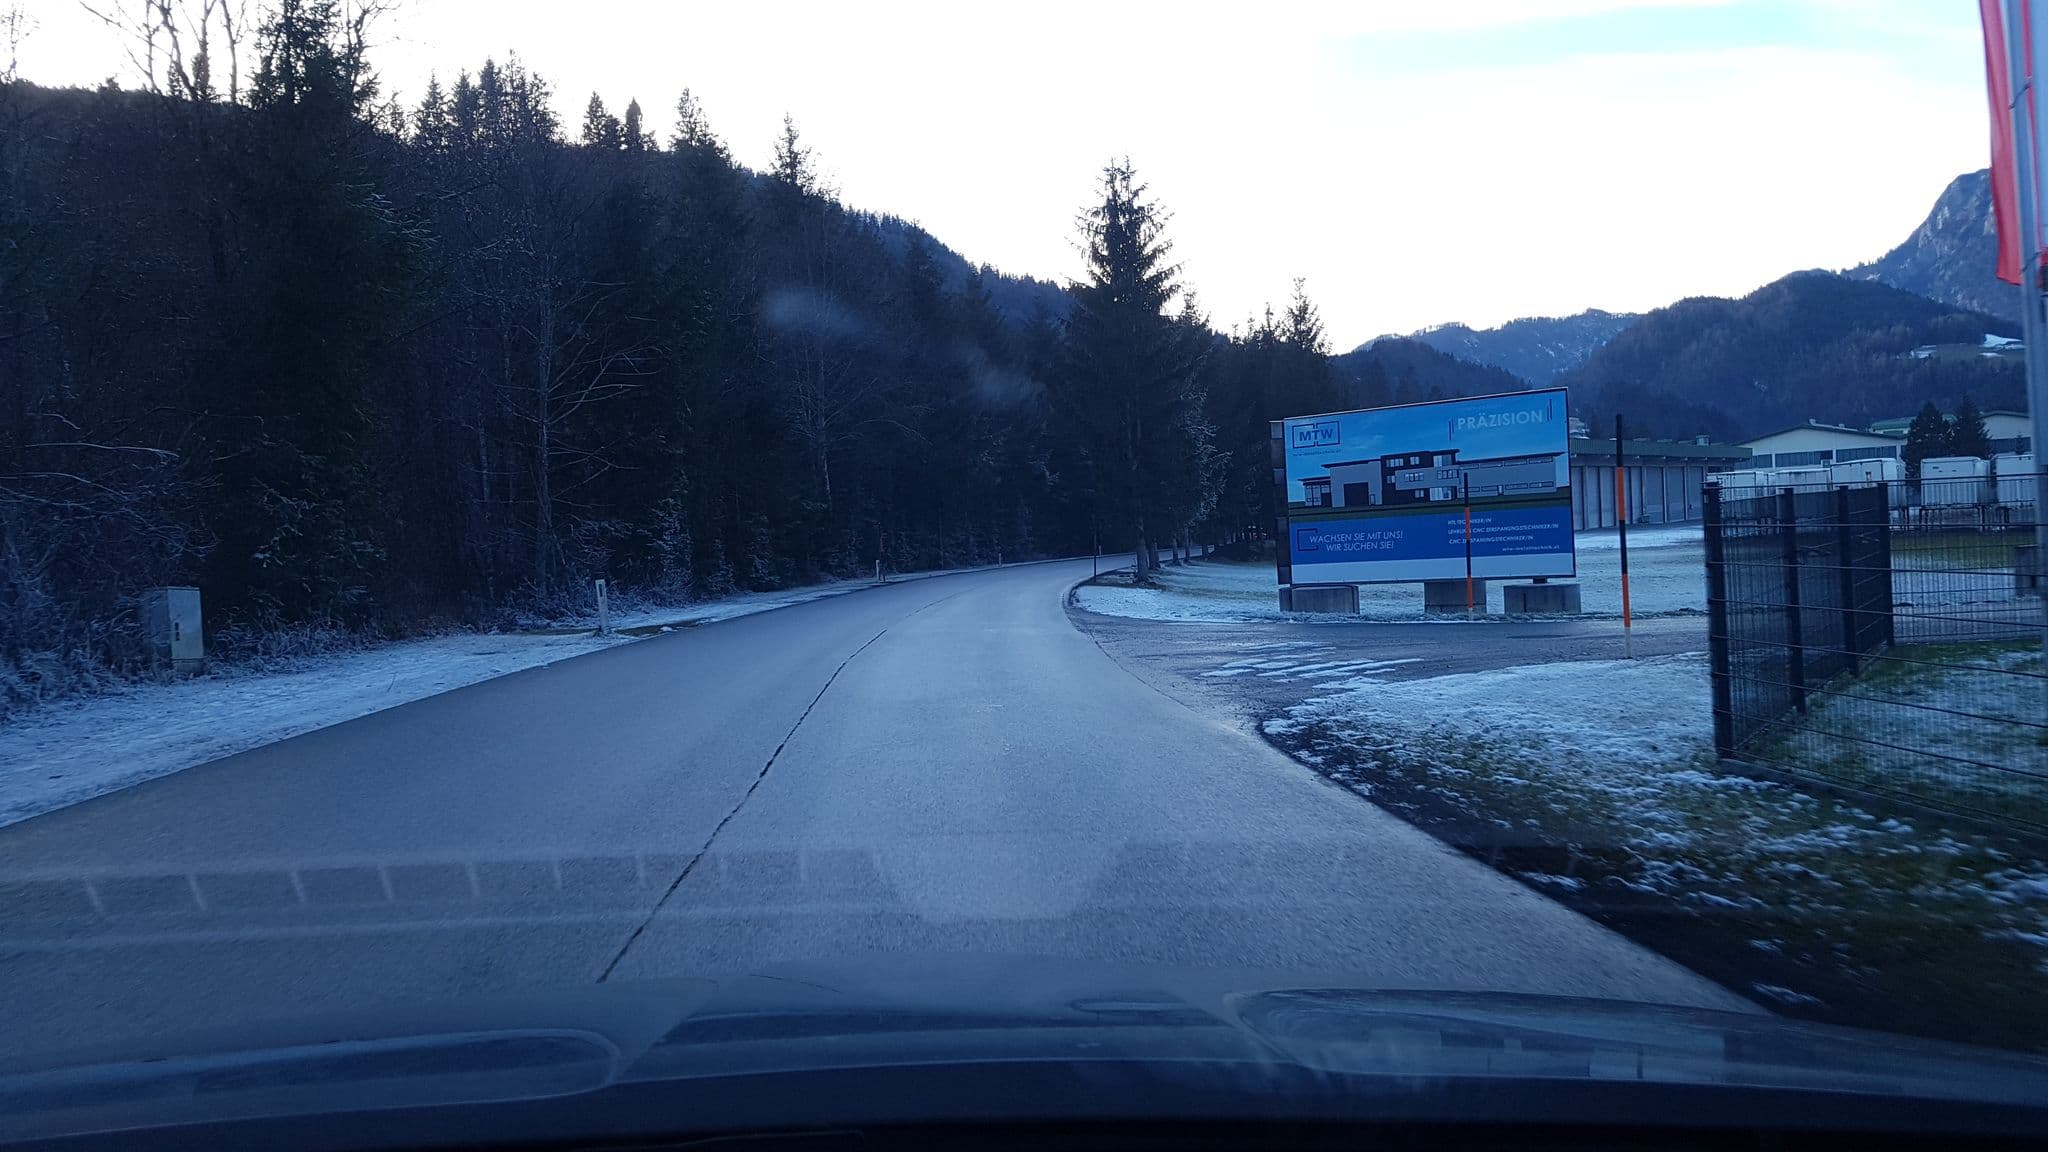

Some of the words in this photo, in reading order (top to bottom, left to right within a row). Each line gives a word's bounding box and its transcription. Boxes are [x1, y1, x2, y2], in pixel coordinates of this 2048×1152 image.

[1457, 409, 1543, 430] PRÄZISION
[1299, 428, 1333, 442] MTW
[1309, 533, 1352, 544] WACHSEN
[1354, 532, 1366, 541] SIE
[1367, 531, 1382, 541] MIT
[1383, 530, 1403, 540] UNS!
[1326, 543, 1342, 552] WIR
[1343, 541, 1378, 552] SUCHEN
[1379, 540, 1394, 550] SIE!
